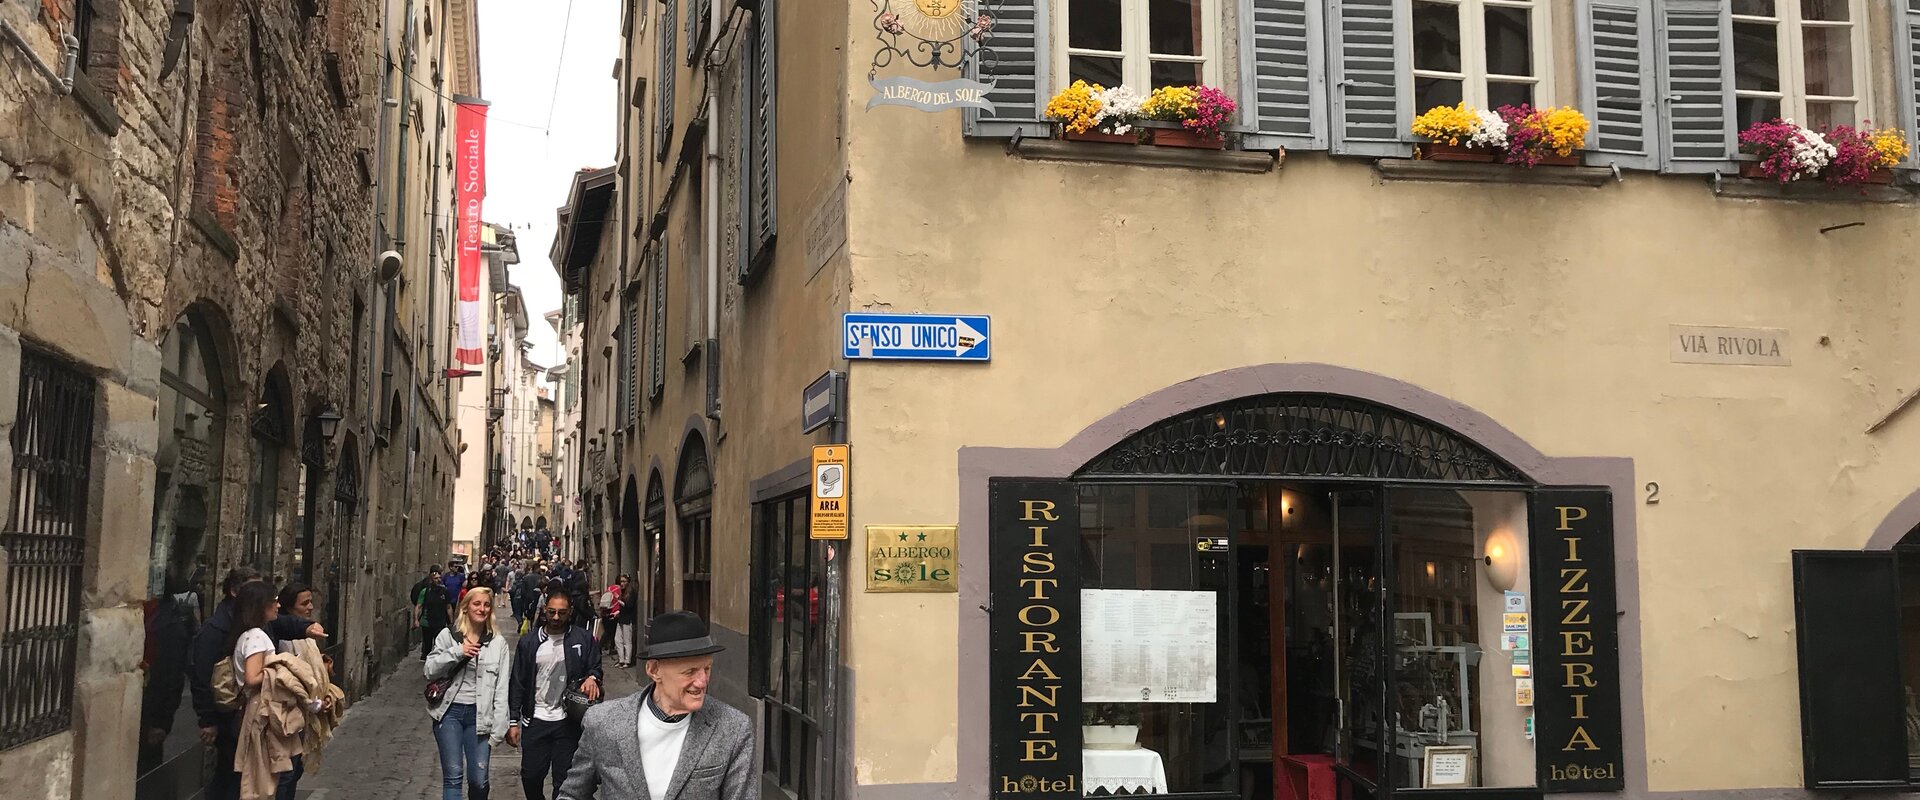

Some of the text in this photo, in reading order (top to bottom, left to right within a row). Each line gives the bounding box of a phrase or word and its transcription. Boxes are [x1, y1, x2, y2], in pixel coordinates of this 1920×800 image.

[883, 85, 984, 106] ALBERGO DEL SOLE
[464, 128, 480, 257] Teatro Sociale
[850, 324, 901, 348] SENSO
[911, 325, 957, 348] UNICO
[1679, 334, 1781, 357] VIA RIVOLA
[1645, 482, 1660, 505] 2
[819, 500, 840, 511] AREA
[875, 546, 951, 559] ALBERGO
[1016, 500, 1063, 762] RISTORANTE
[1554, 506, 1602, 751] PIZZERIA
